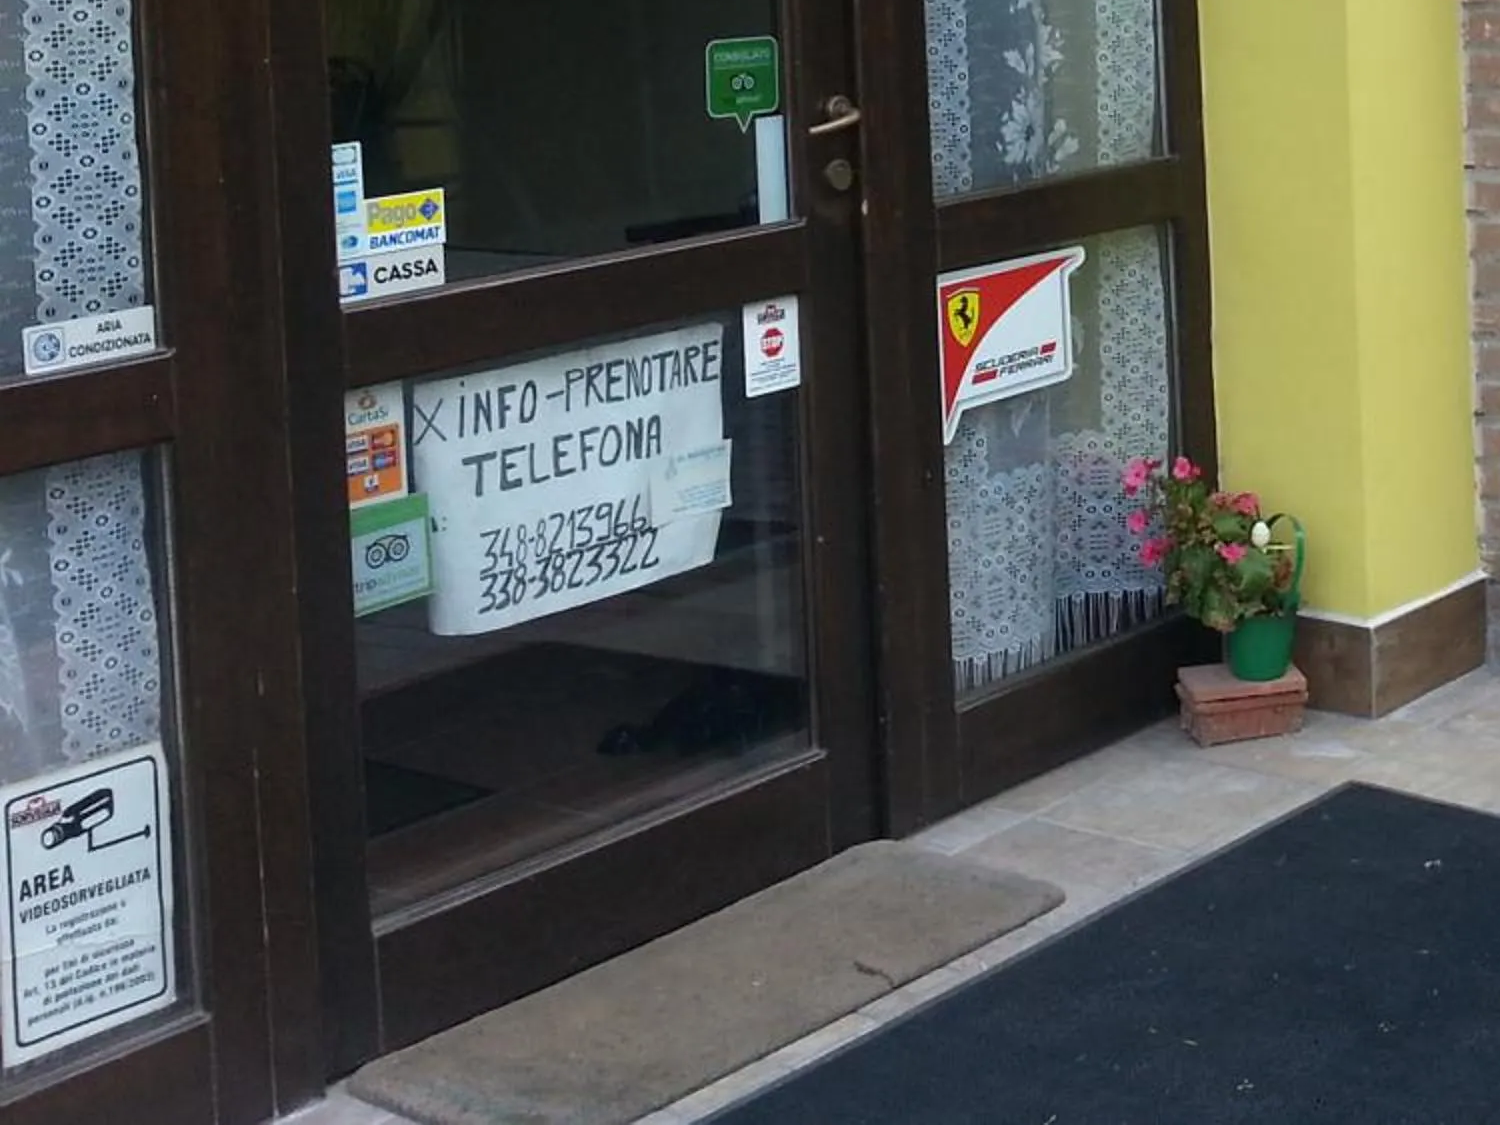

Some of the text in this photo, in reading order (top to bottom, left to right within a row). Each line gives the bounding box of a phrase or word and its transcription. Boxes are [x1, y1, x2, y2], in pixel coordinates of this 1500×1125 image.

[367, 201, 417, 227] Pago
[369, 227, 441, 249] BANCOMAT
[373, 259, 438, 284] CASSA
[96, 319, 122, 334] ARIA
[69, 333, 151, 358] CONDIZIONATA
[976, 346, 1039, 370] SCUDERIA
[461, 414, 662, 498] TELEFONA
[479, 494, 650, 575] 348-8213966
[478, 527, 660, 614] 338-3823322
[19, 864, 75, 902] AREA
[19, 867, 151, 924] VIDEOSORVEGLIATA
